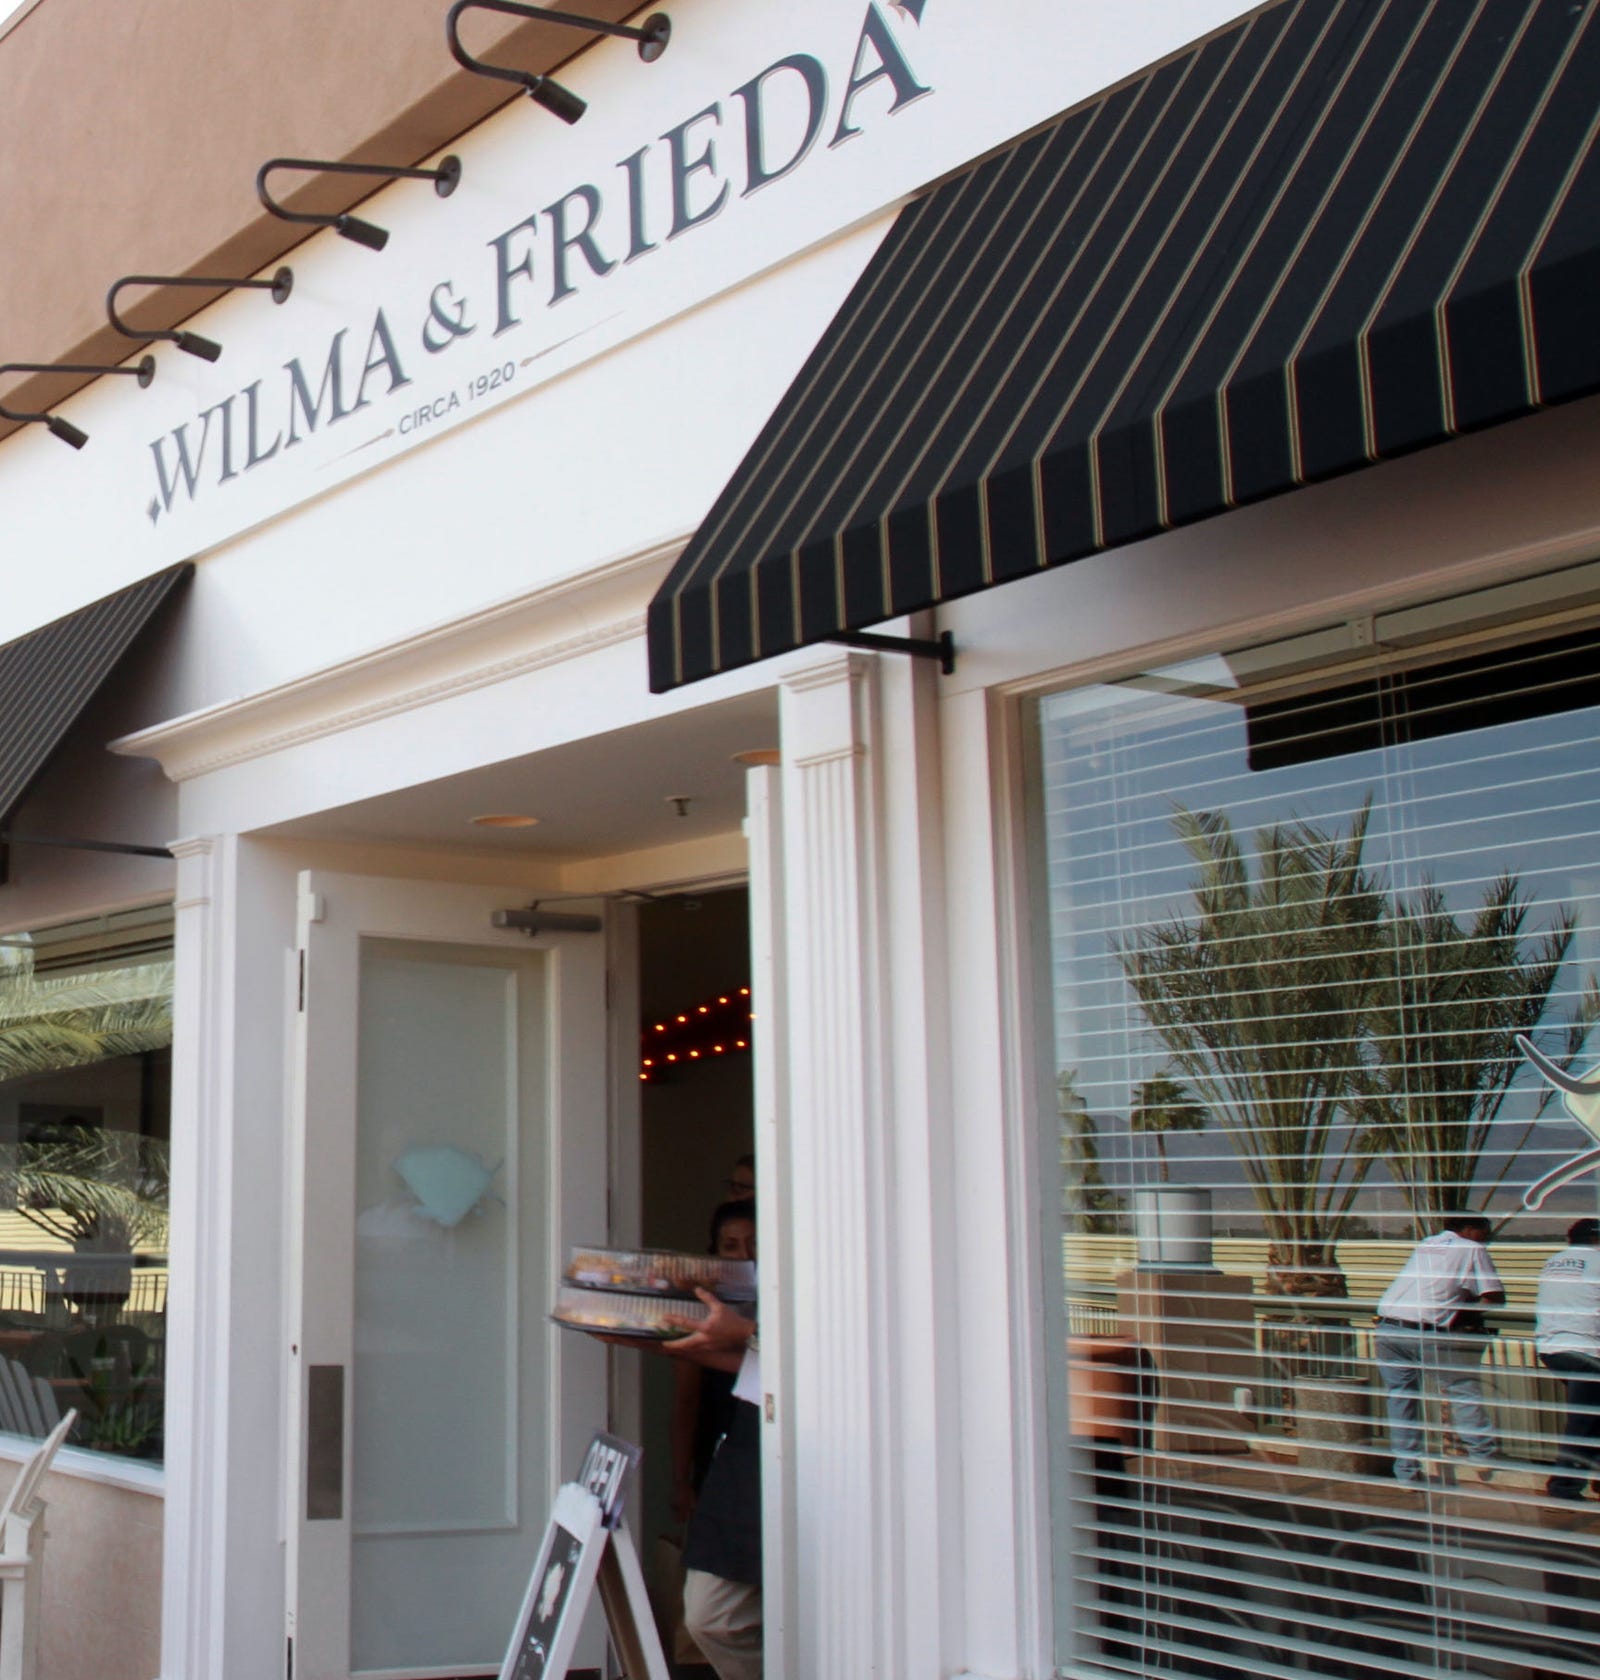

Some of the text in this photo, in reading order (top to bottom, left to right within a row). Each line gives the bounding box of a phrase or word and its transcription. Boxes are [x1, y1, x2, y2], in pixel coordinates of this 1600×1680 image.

[148, 306, 413, 513] WILMA
[422, 281, 478, 354] &
[398, 361, 516, 435] CIRCA 1920
